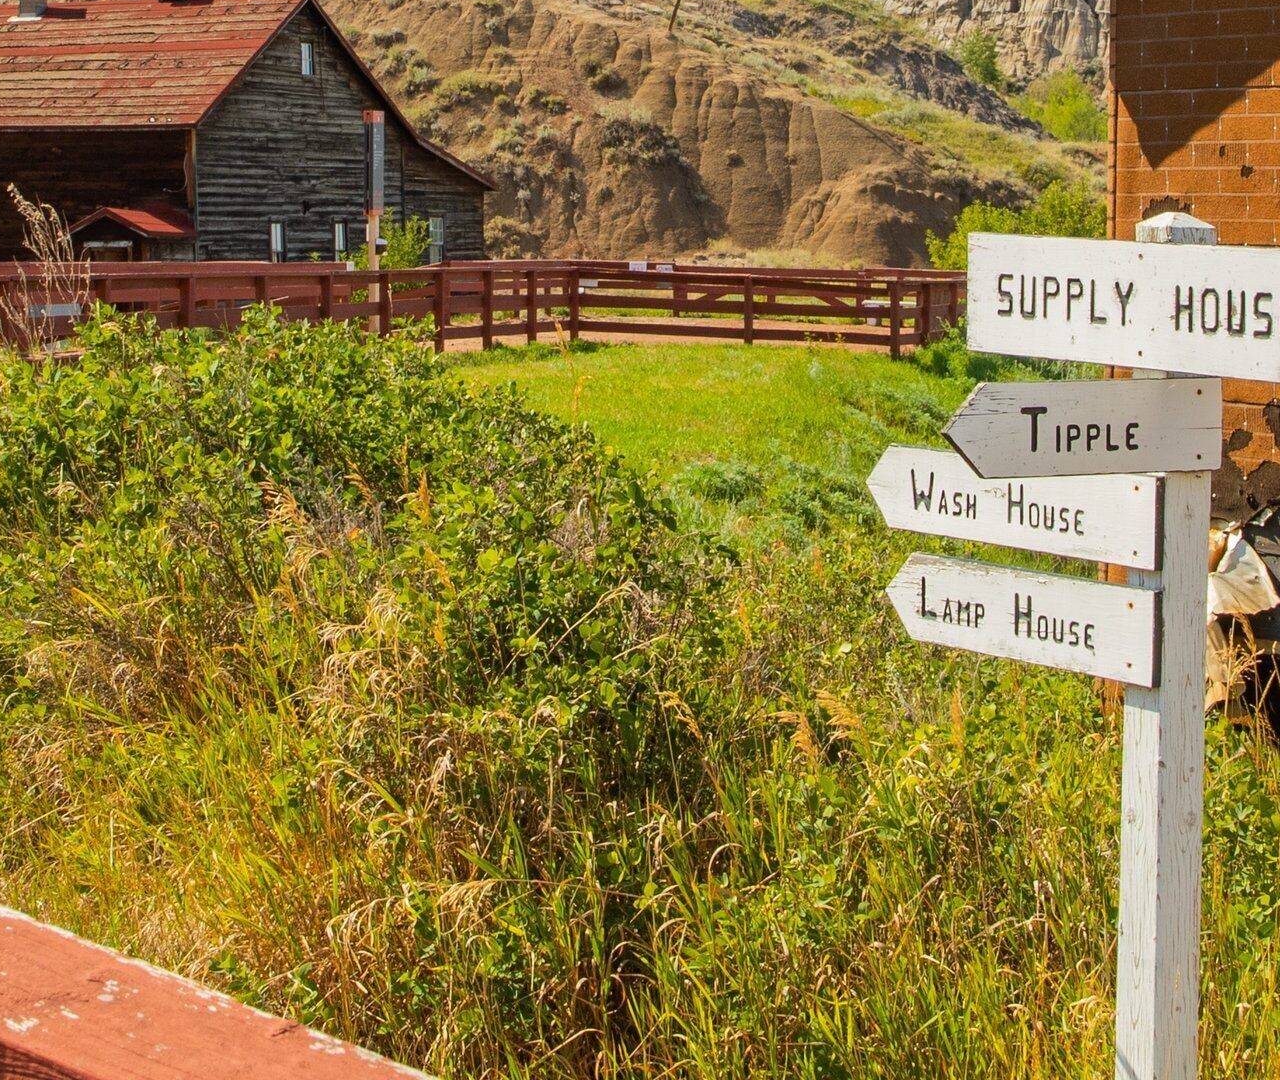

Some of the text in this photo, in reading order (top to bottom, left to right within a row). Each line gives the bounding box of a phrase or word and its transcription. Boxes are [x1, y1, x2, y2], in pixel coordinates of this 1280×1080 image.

[996, 273, 1135, 326] SUPPLY
[1020, 406, 1140, 454] TIPPLE
[910, 468, 1086, 535] WASH HOUSE
[919, 576, 1096, 651] LAMP HOUSE
